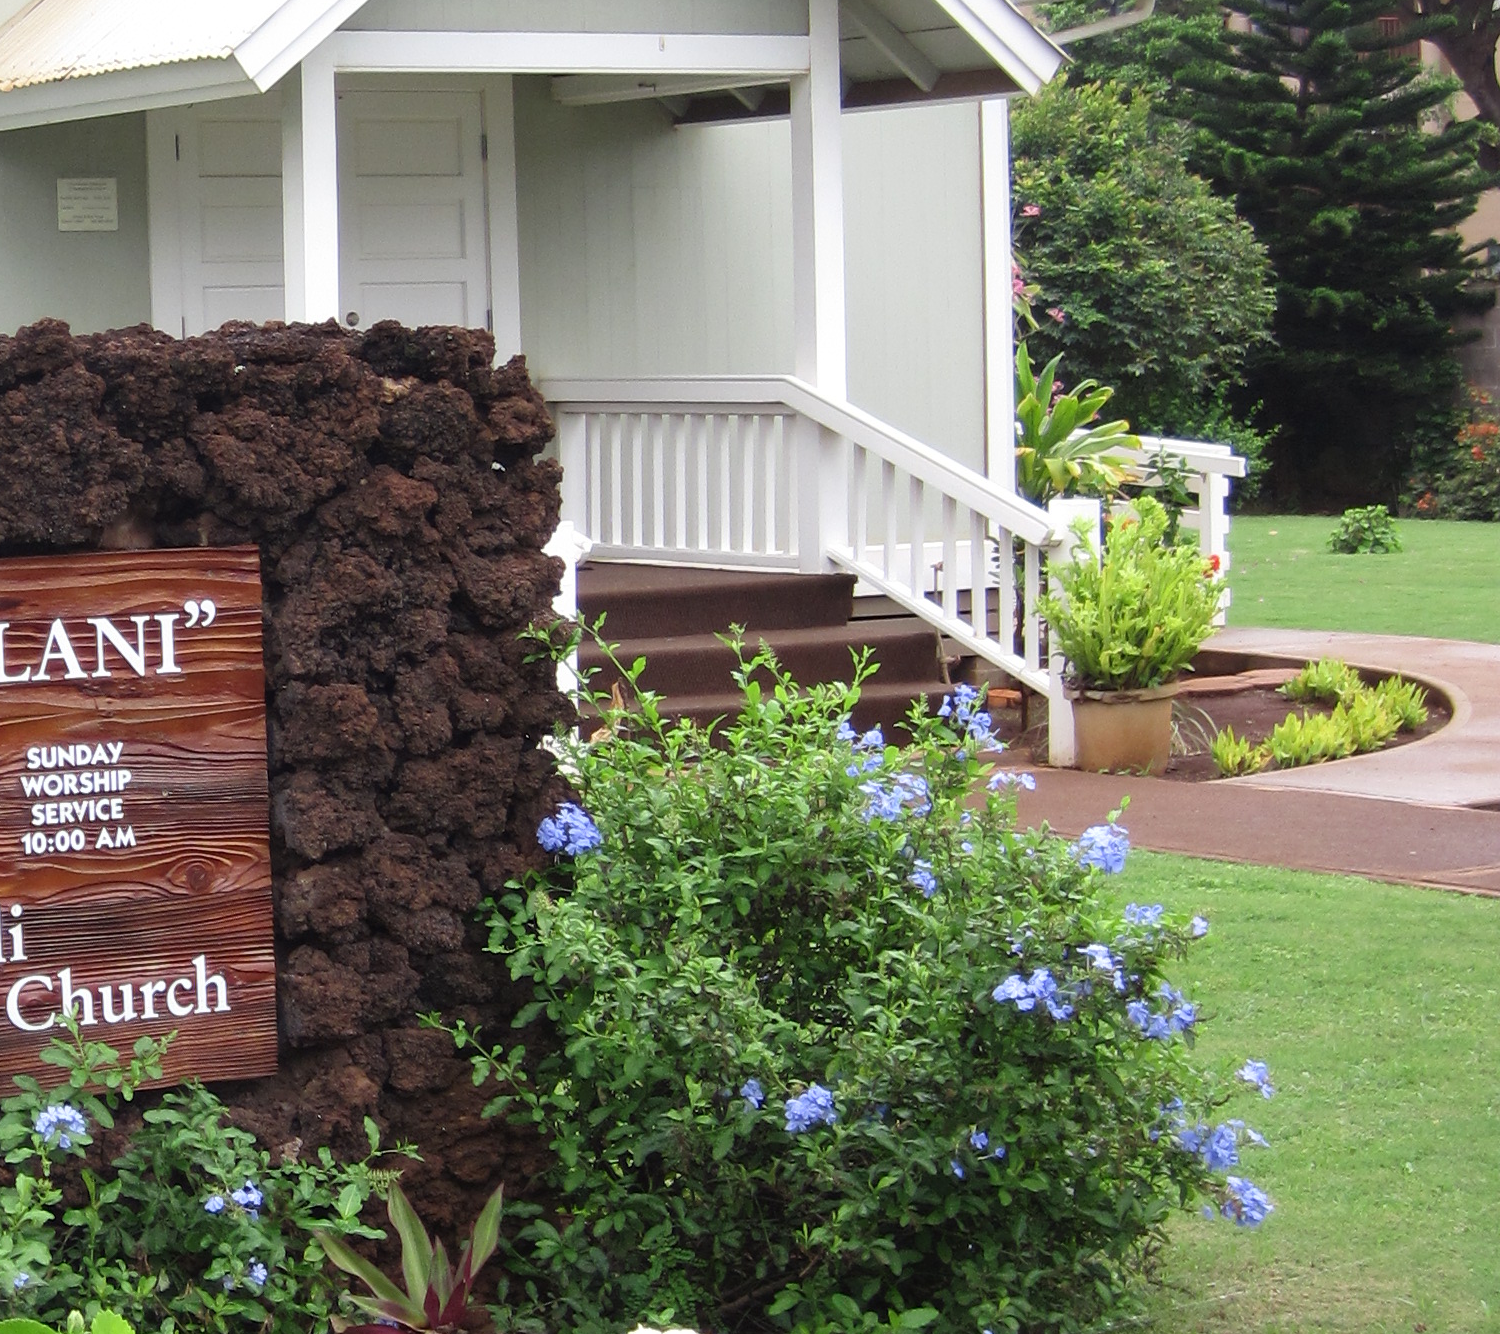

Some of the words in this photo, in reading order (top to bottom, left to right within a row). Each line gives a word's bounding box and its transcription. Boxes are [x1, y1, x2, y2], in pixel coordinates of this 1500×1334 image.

[26, 741, 125, 769] SUNDAY
[20, 769, 133, 797] WORSHIP
[30, 798, 125, 824] SERVICE
[20, 829, 86, 855] 10:00
[94, 825, 137, 850] AM
[5, 956, 231, 1034] Church
